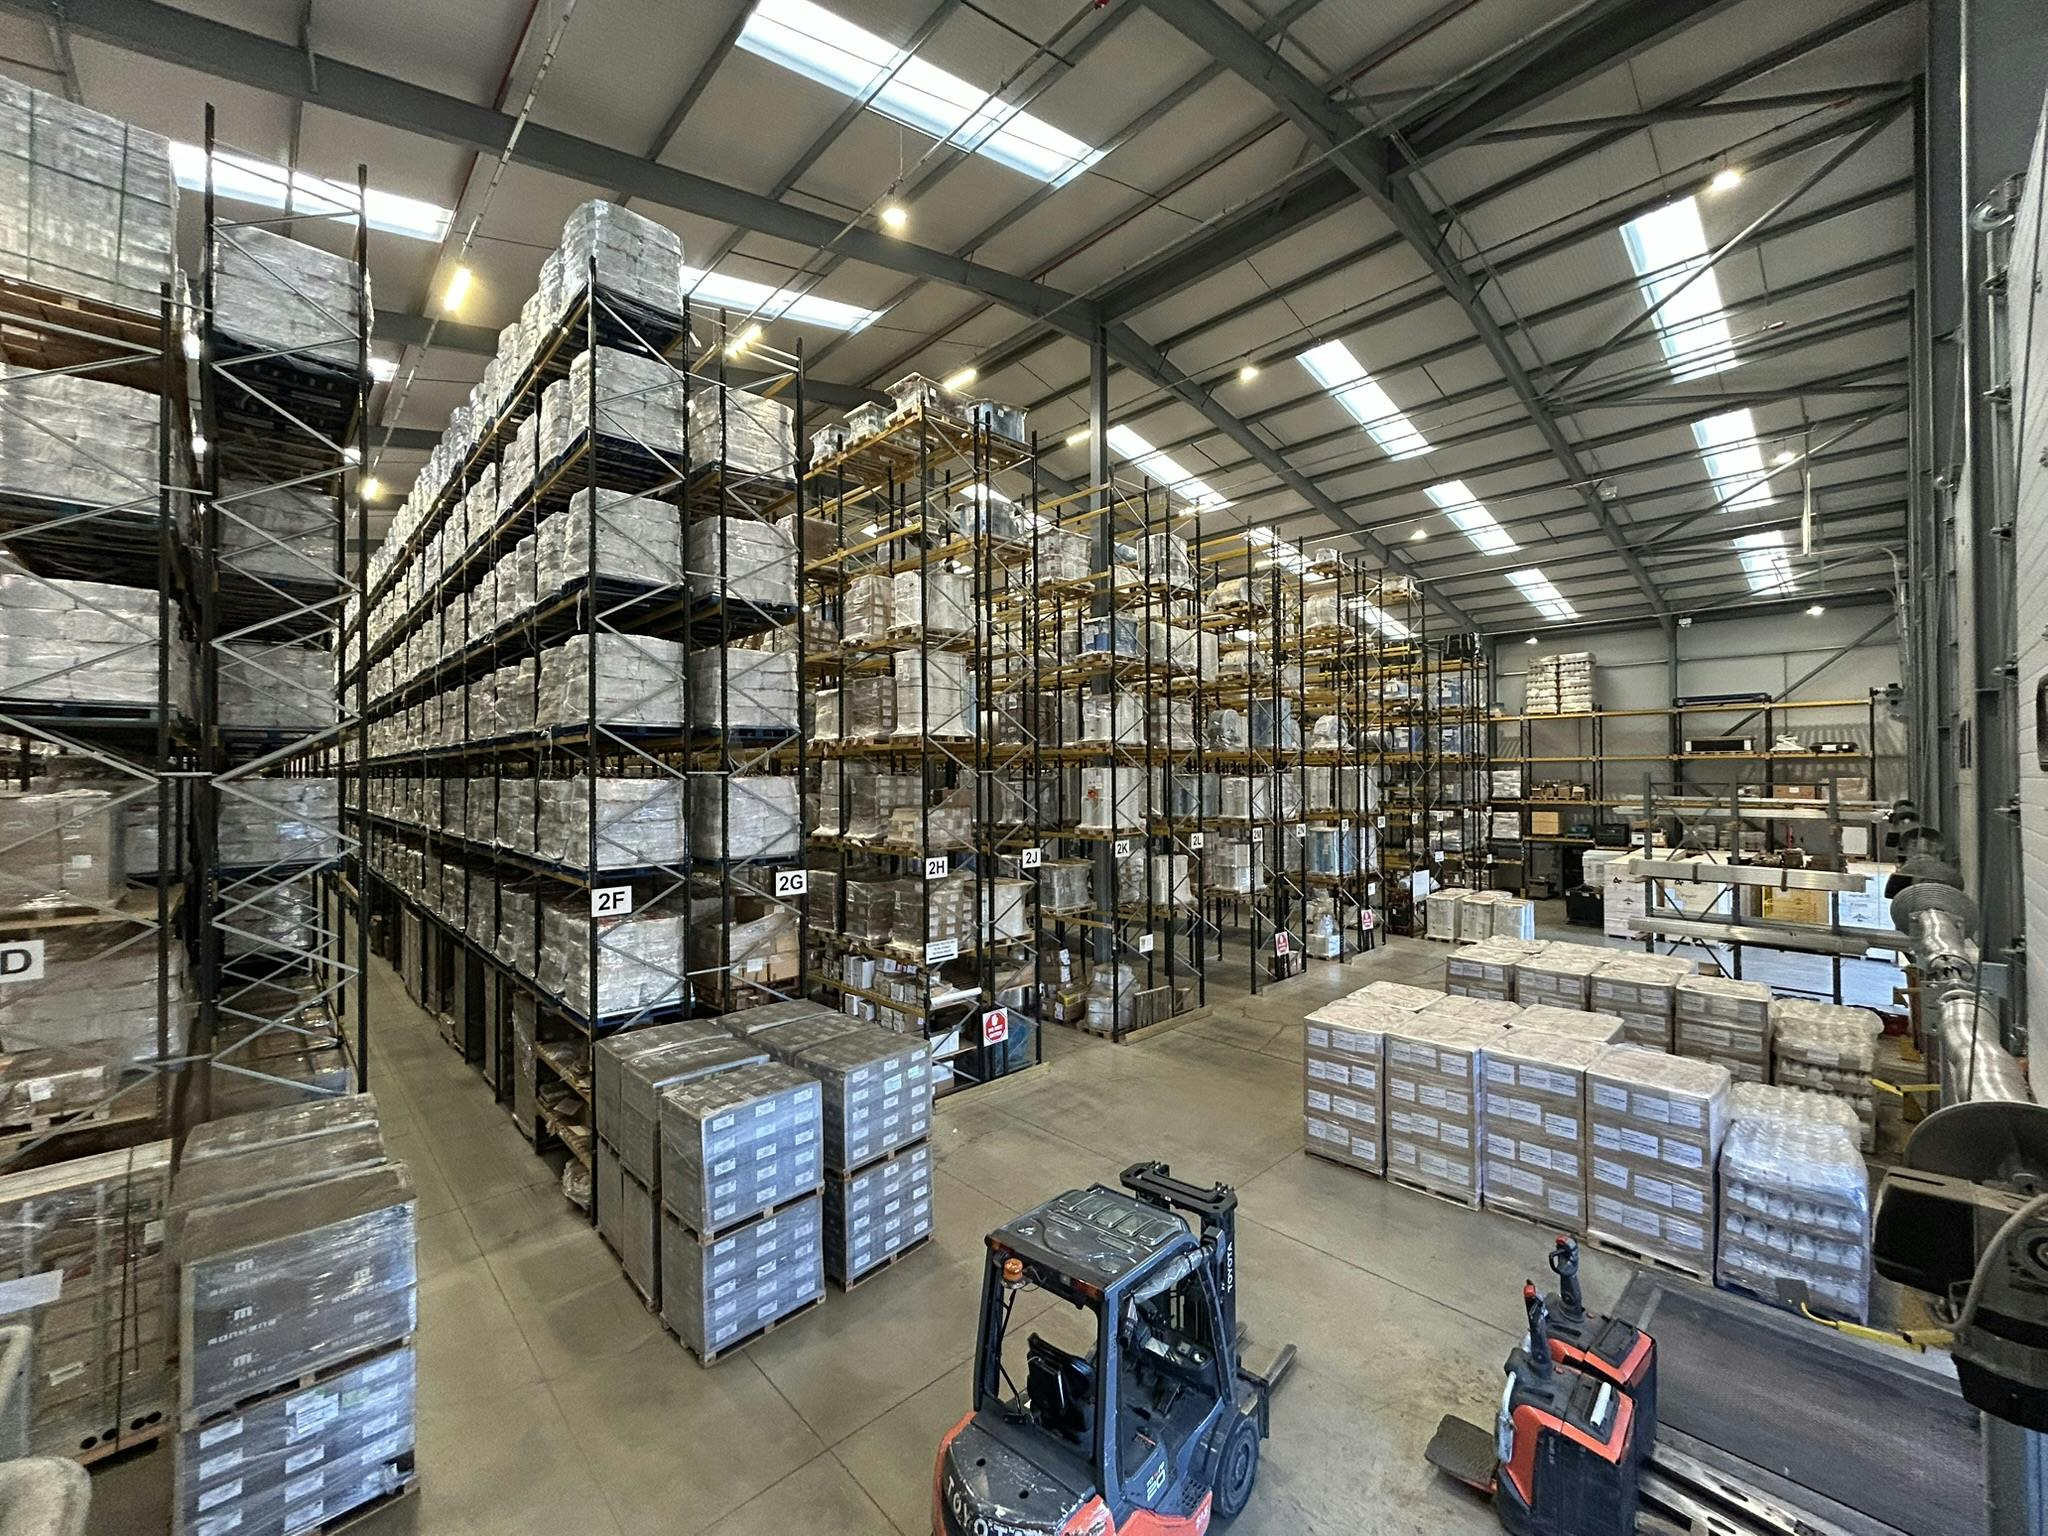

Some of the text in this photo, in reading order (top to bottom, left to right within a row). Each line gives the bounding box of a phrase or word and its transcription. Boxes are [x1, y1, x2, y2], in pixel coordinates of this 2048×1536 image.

[1192, 835, 1201, 846] 2L
[1253, 829, 1262, 840] 2M
[1117, 843, 1128, 855] 2K
[1025, 851, 1038, 864] 2J
[928, 860, 945, 875] 2H
[779, 874, 804, 891] 2G
[598, 891, 626, 911] 2F
[0, 948, 33, 976] D
[1146, 1469, 1166, 1502] 20
